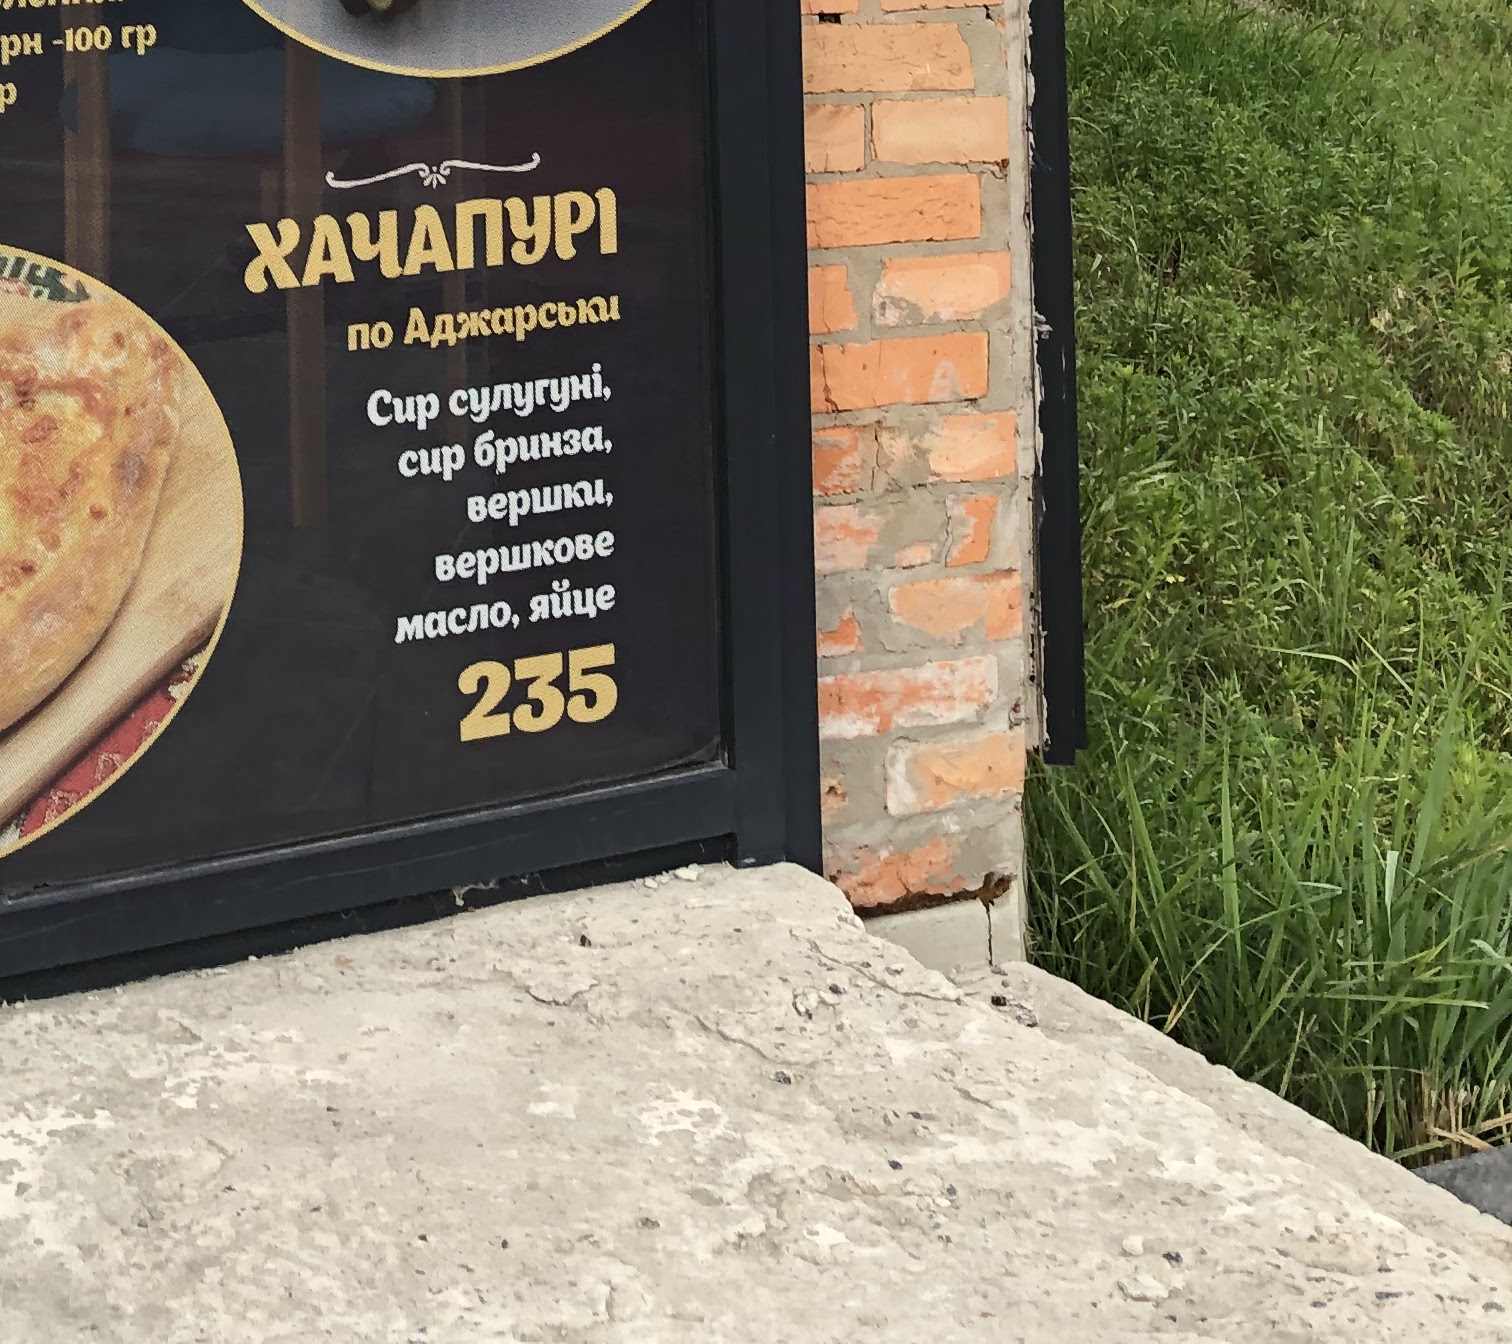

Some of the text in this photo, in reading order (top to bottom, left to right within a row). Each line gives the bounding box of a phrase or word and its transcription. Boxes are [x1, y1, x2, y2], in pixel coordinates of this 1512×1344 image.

[52, 25, 113, 53] -100
[121, 22, 157, 55] гр
[244, 187, 618, 294] ХАЧАПУРІ
[347, 293, 620, 352] по Аджарськи
[366, 362, 612, 431] Сир сулугуні,
[397, 424, 613, 481] сир бринза,
[466, 479, 614, 528] вершки,
[434, 529, 615, 585] вершкове
[394, 579, 616, 644] масло, яйце
[457, 642, 619, 743] 235
